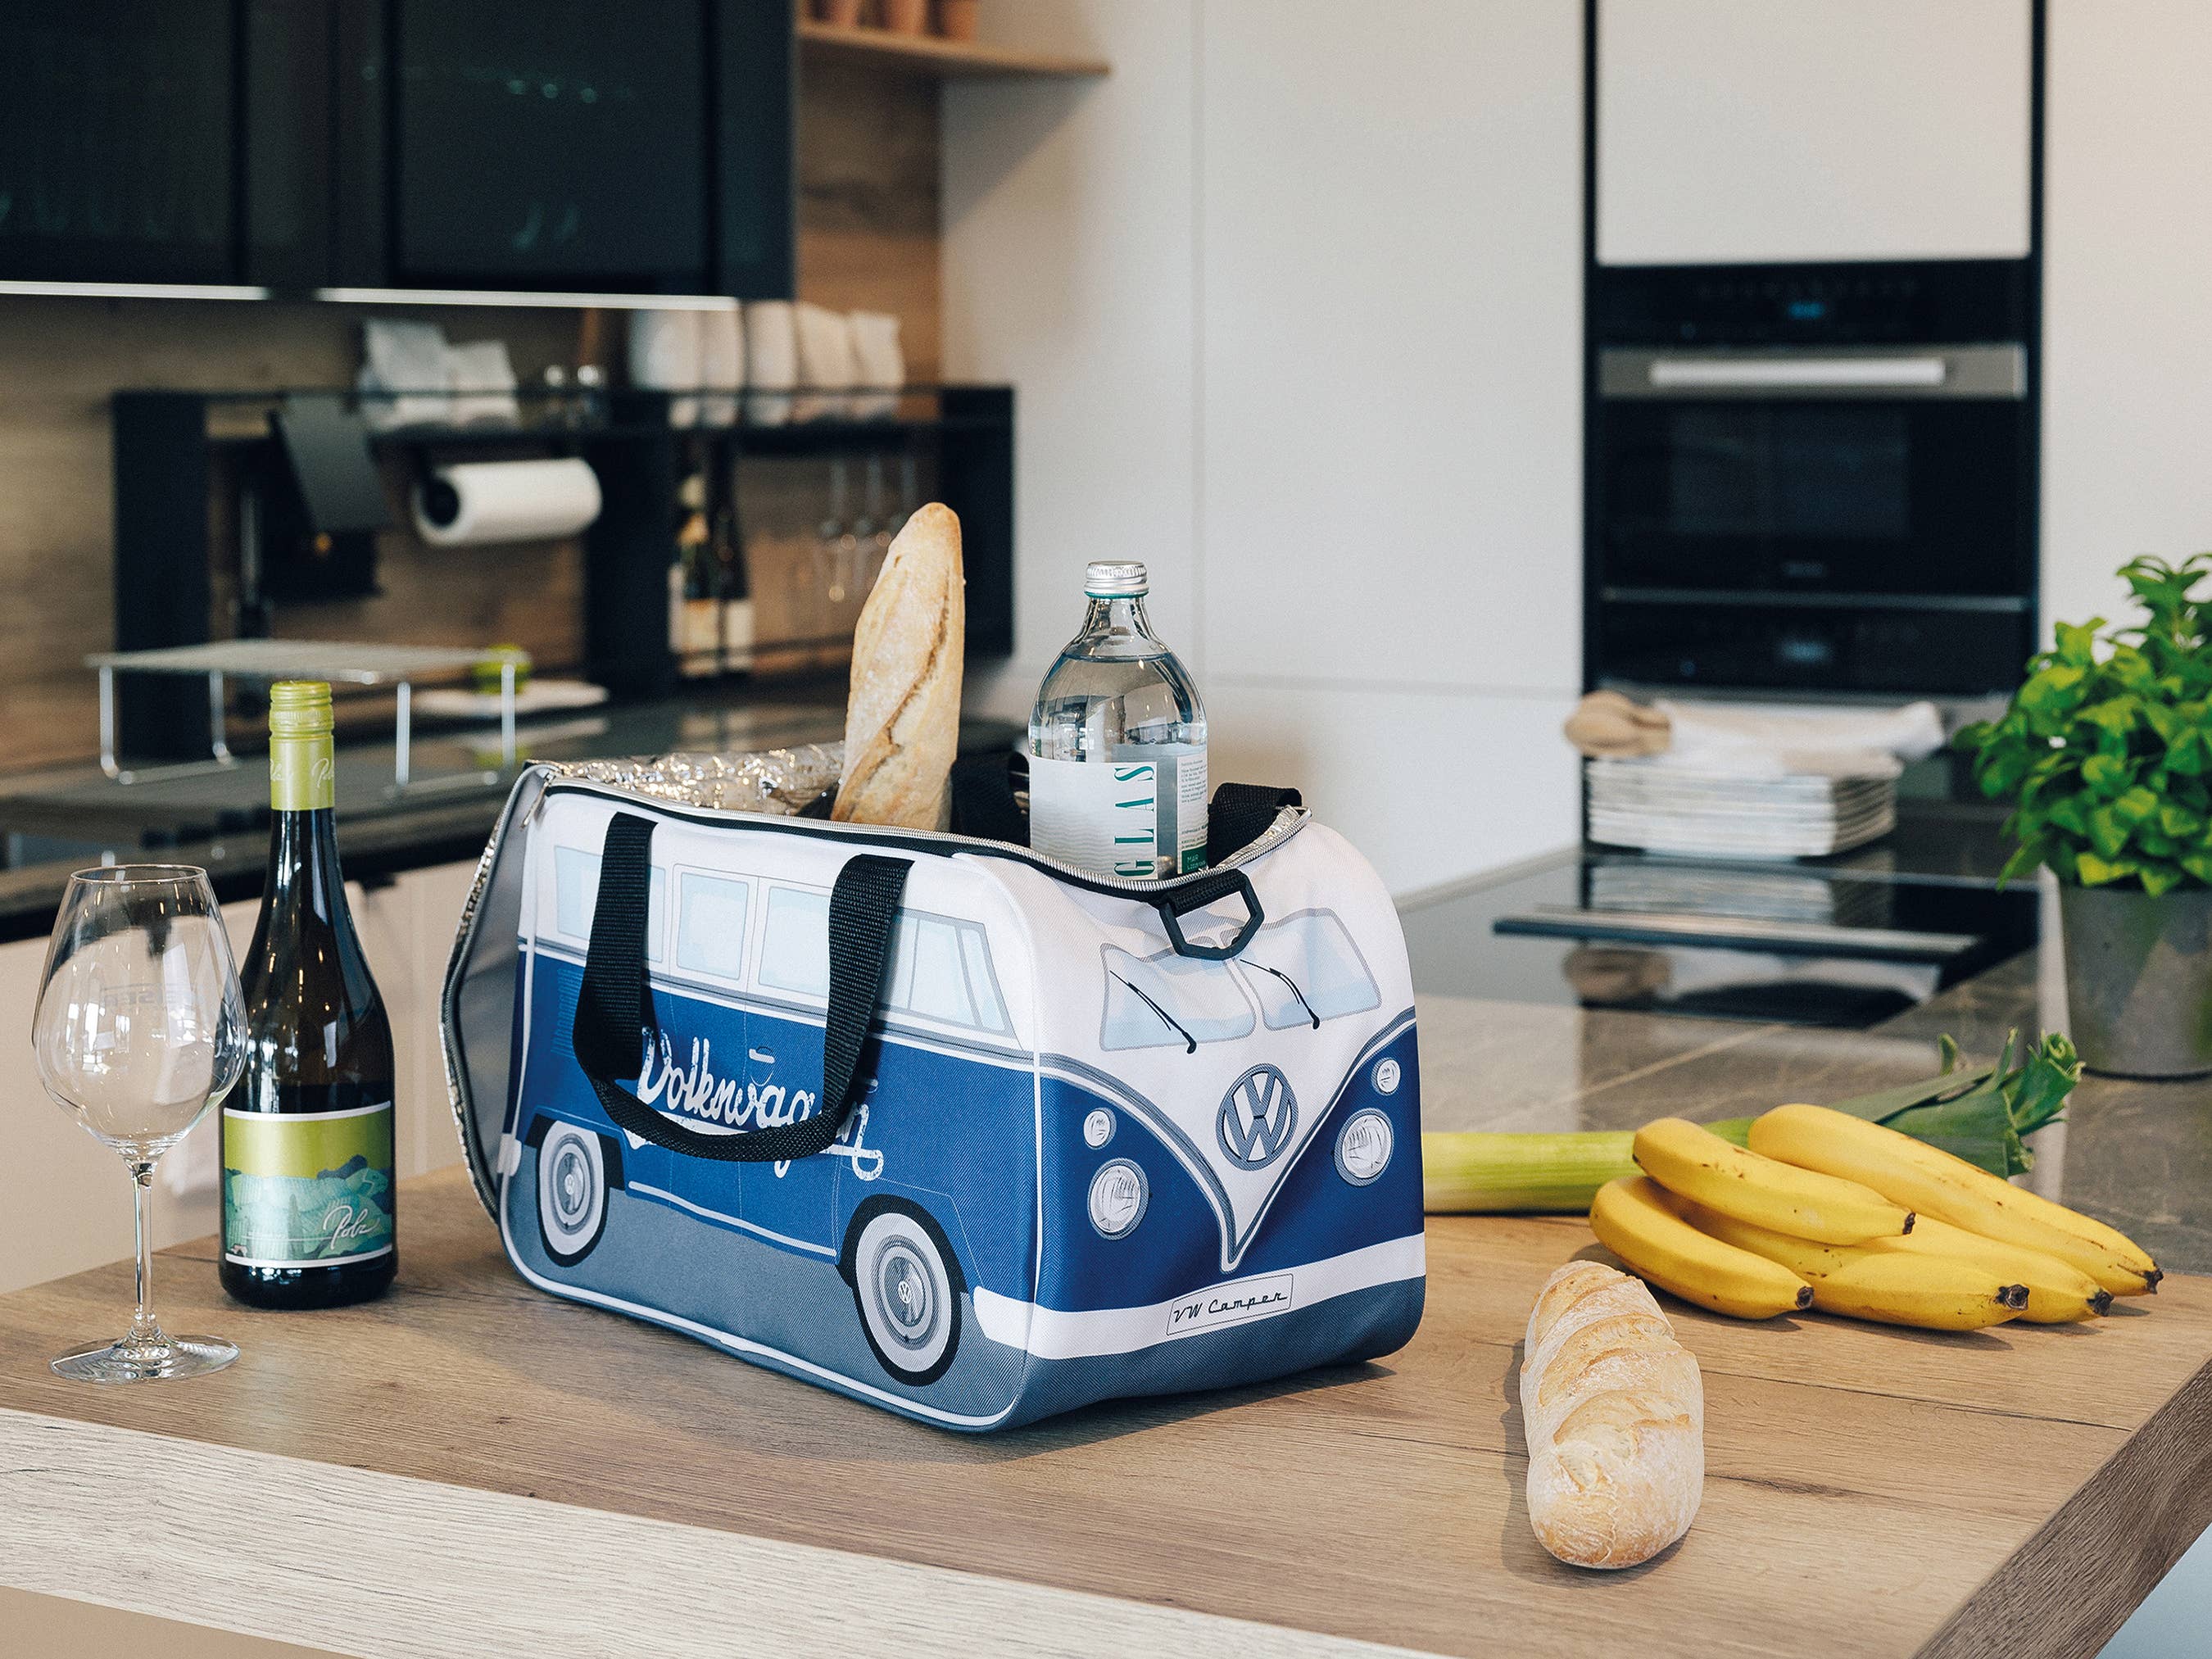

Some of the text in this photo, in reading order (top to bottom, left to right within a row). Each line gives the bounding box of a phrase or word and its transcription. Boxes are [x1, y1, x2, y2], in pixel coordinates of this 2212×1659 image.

[1114, 766, 1154, 877] GLAS
[1219, 1065, 1296, 1169] VW
[323, 1205, 380, 1250] Polz
[1174, 1293, 1288, 1323] VW Camper
